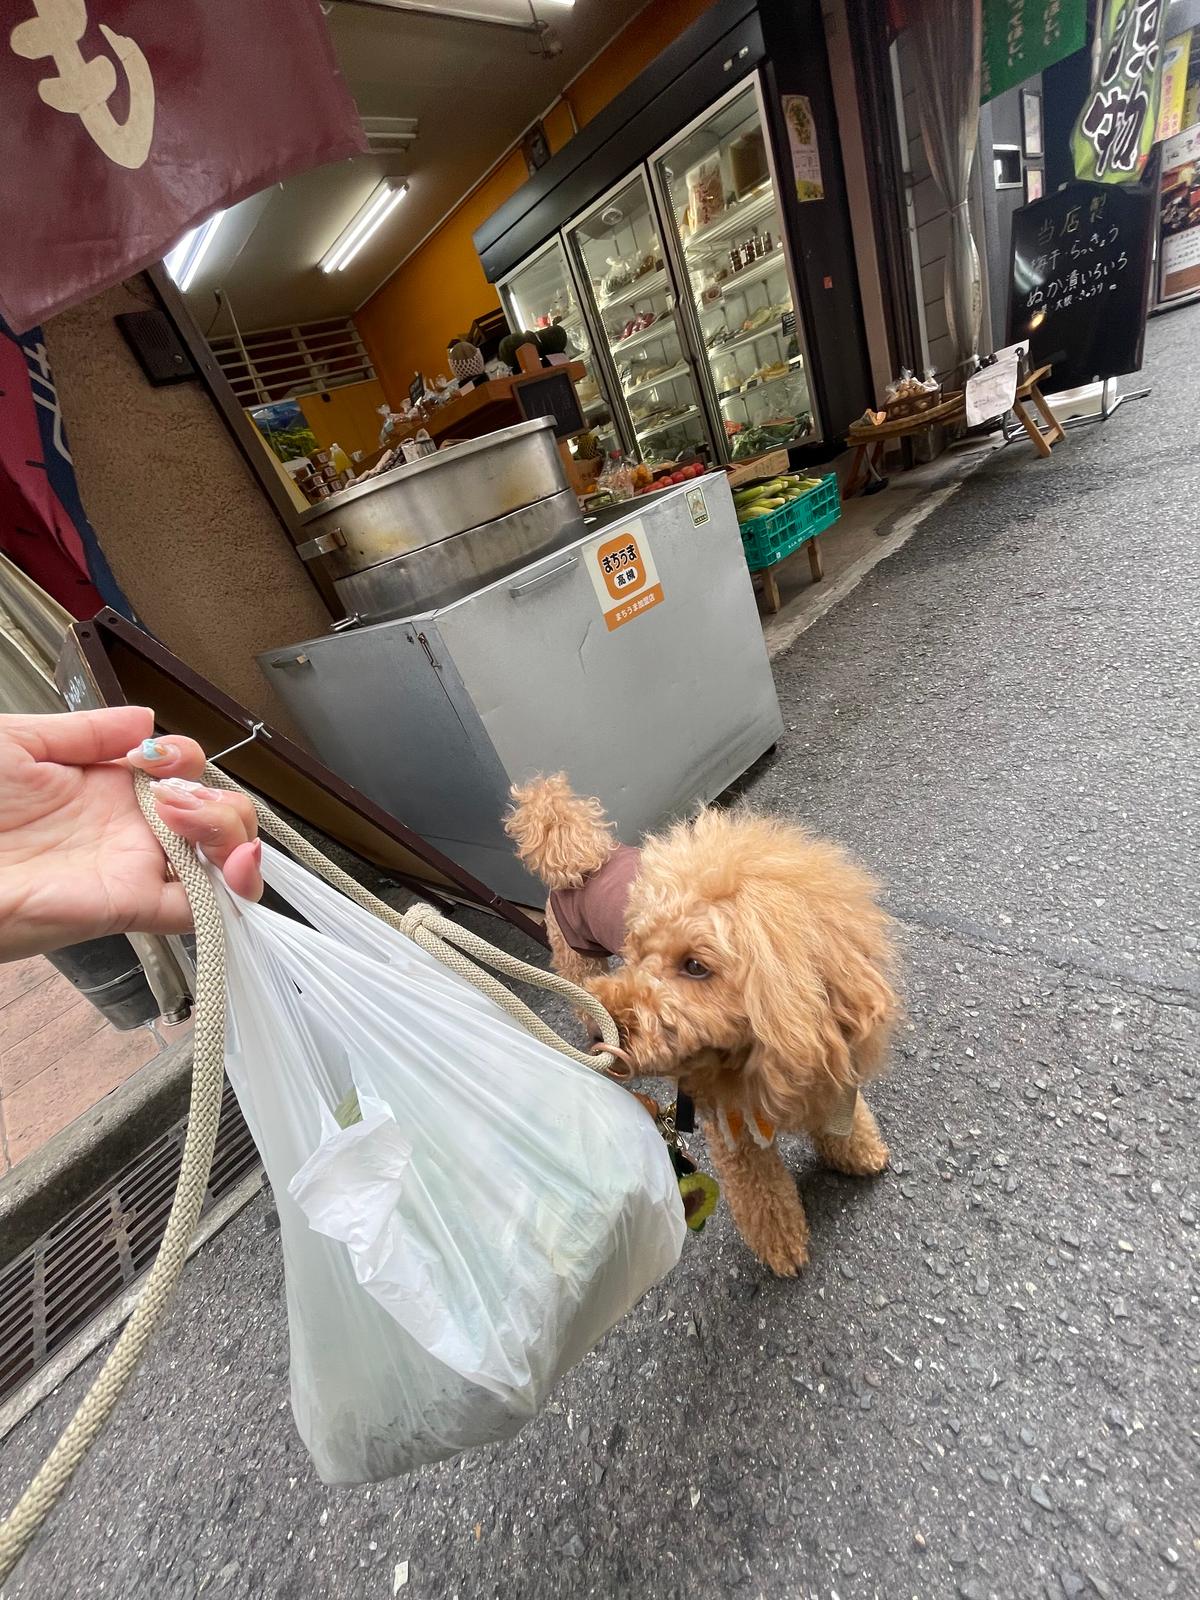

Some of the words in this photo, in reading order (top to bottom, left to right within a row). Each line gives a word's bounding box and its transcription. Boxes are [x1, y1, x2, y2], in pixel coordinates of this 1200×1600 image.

[1026, 251, 1128, 308] ぬか漬いろいろ
[602, 544, 637, 573] まちうま
[616, 568, 636, 587] 高槻
